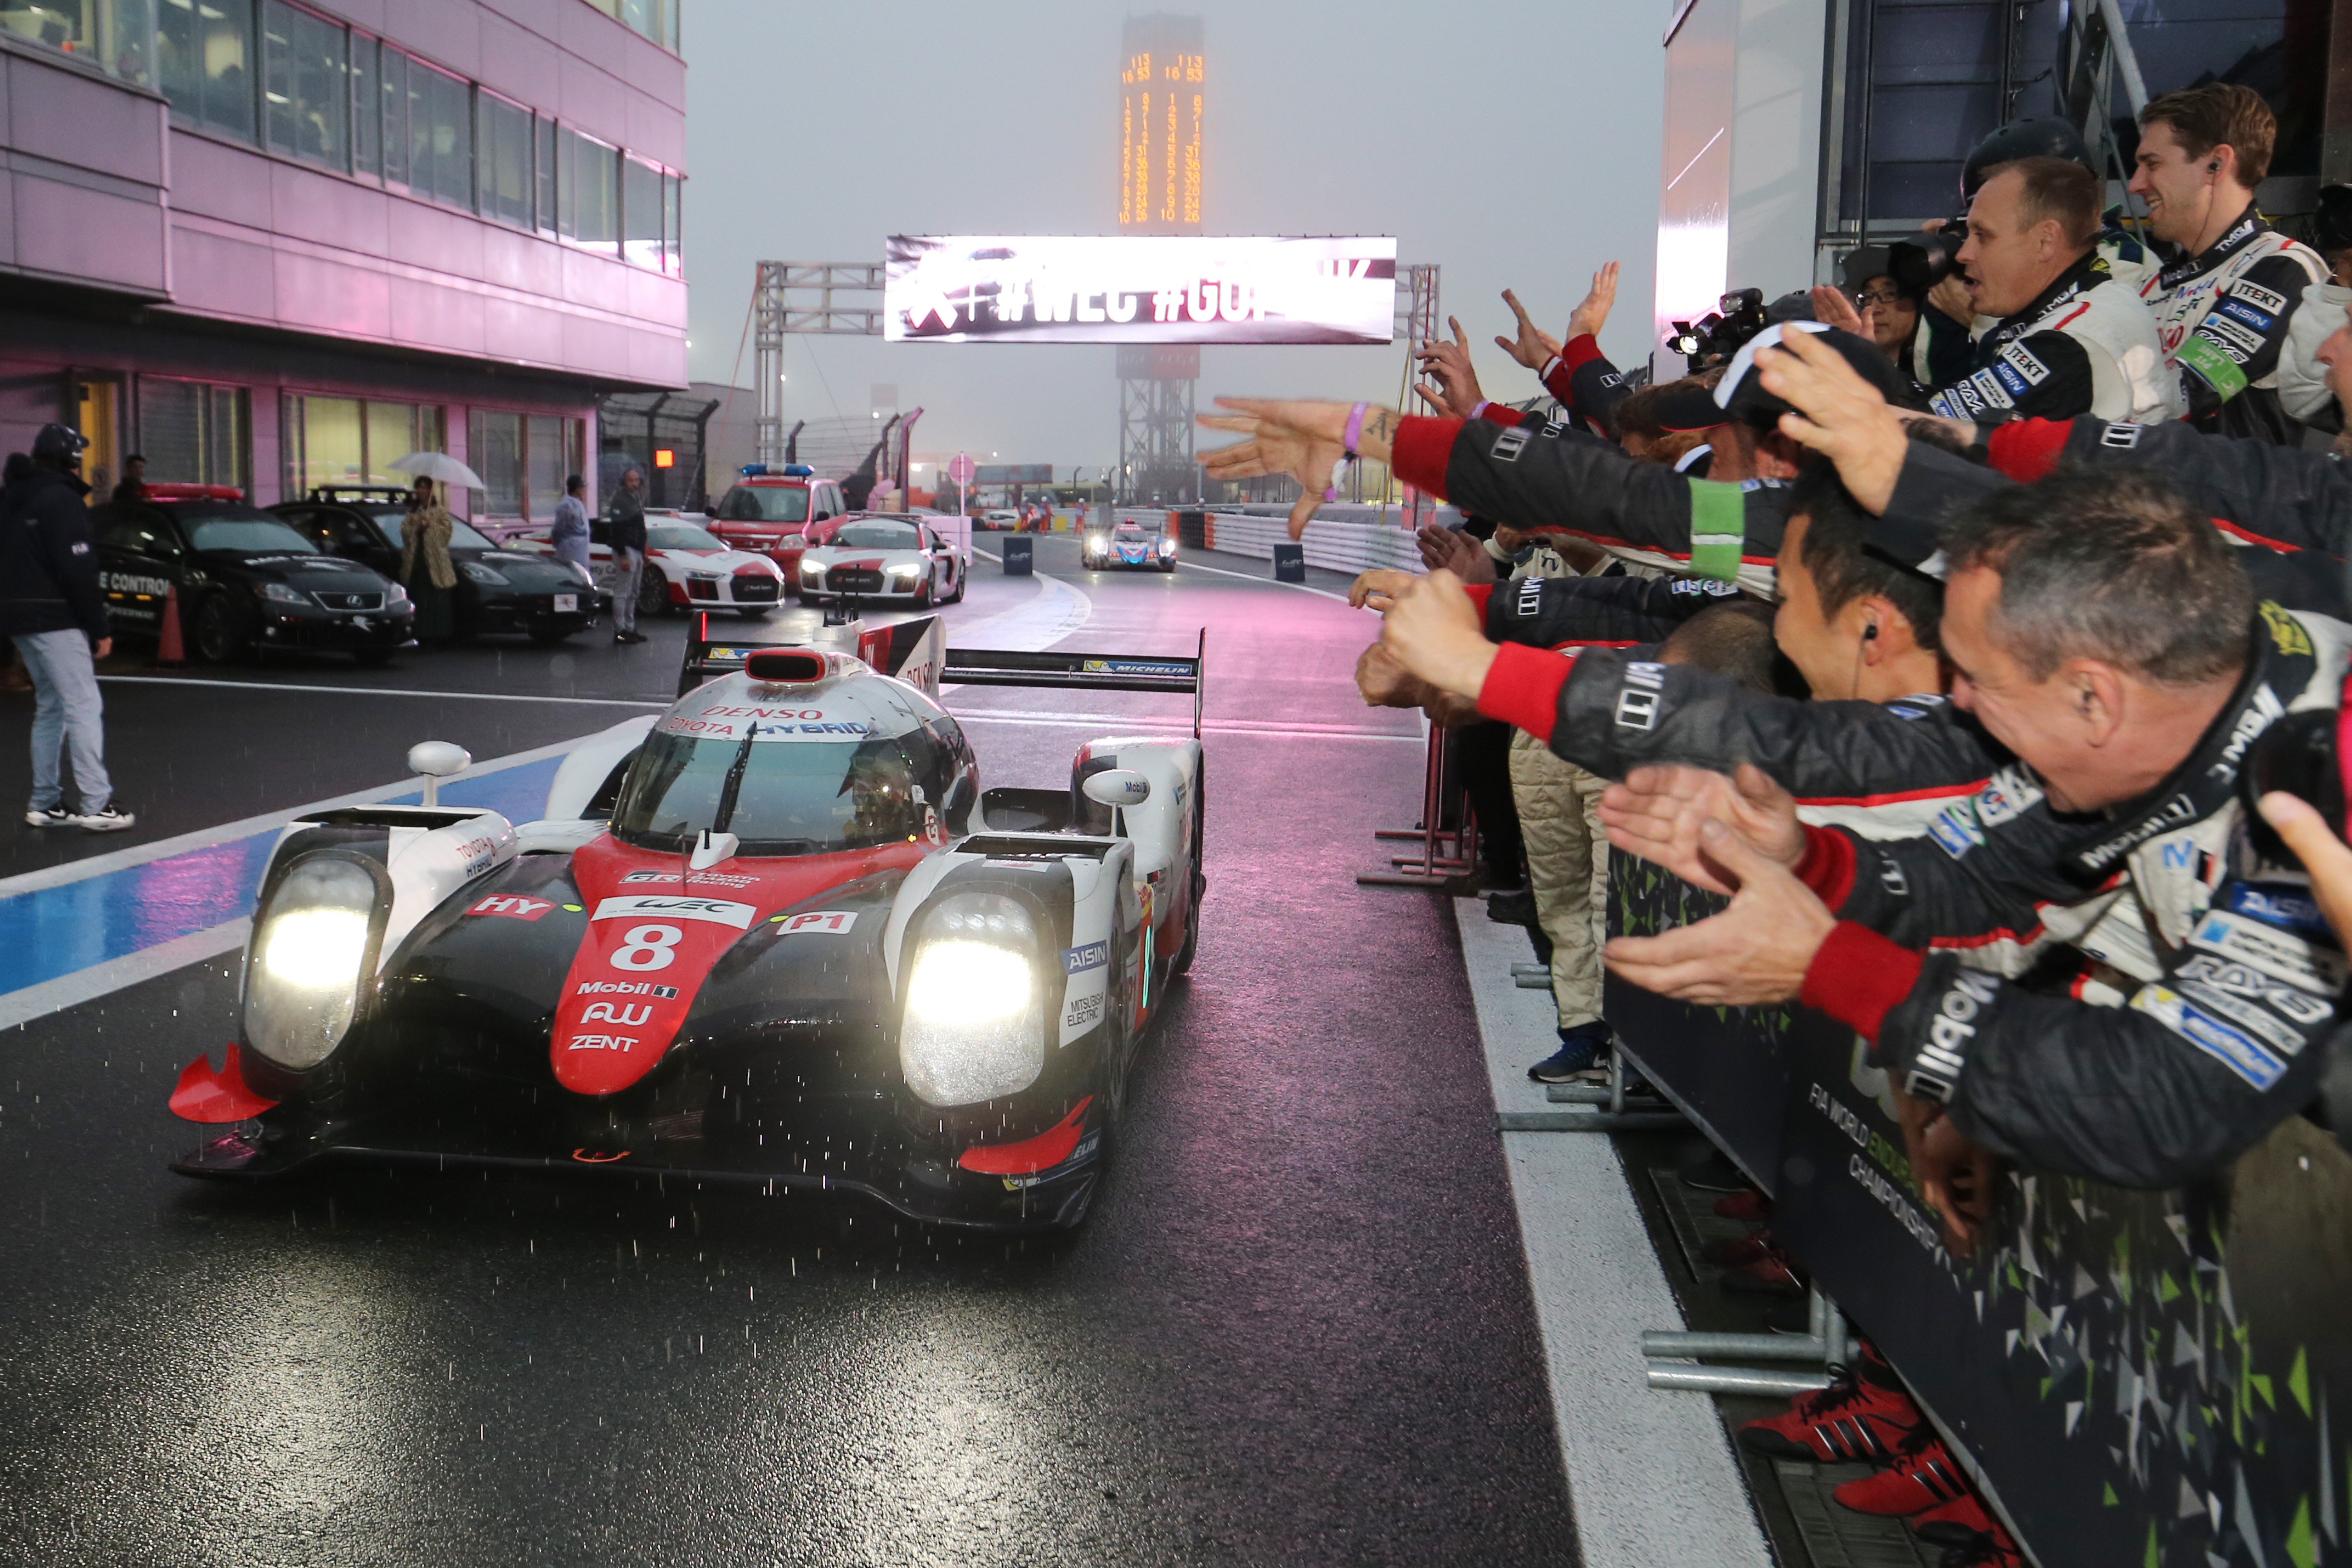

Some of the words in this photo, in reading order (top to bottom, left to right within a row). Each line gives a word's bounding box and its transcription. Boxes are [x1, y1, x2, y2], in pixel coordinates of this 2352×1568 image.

[1119, 211, 1130, 224] 10
[1161, 208, 1175, 222] 10
[2235, 283, 2283, 308] JTEKT
[2225, 303, 2269, 326] AISIN
[2006, 345, 2045, 378] JTEKT
[1996, 362, 2024, 391] AISIN
[1520, 576, 1545, 594] bil
[1116, 665, 1190, 674] MICHELIN
[701, 706, 823, 720] DENSO
[668, 717, 732, 735] TOYOTA
[755, 721, 870, 735] HYBRID
[456, 838, 489, 859] TOYOTA
[487, 837, 496, 857] 8
[623, 873, 681, 883] GR
[686, 879, 745, 889] Racing
[689, 875, 751, 884] GAZOO
[696, 872, 761, 881] TOYOTA
[474, 897, 550, 915] HY
[635, 899, 735, 913] WEC
[790, 914, 845, 931] P1
[610, 924, 682, 971] 8
[1069, 945, 1106, 970] AISIN
[577, 981, 651, 995] Mobil
[1071, 992, 1104, 1013] MITSUBISH
[1068, 1008, 1098, 1027] ELECTRIC
[1916, 967, 1999, 1078] Mobil
[568, 1035, 639, 1053] ZENT
[1809, 1083, 1829, 1116] FIA
[1829, 1097, 1869, 1147] WORLD
[1073, 1136, 1098, 1160] ELIN
[1849, 1153, 1940, 1251] CHAMPIONSHIP
